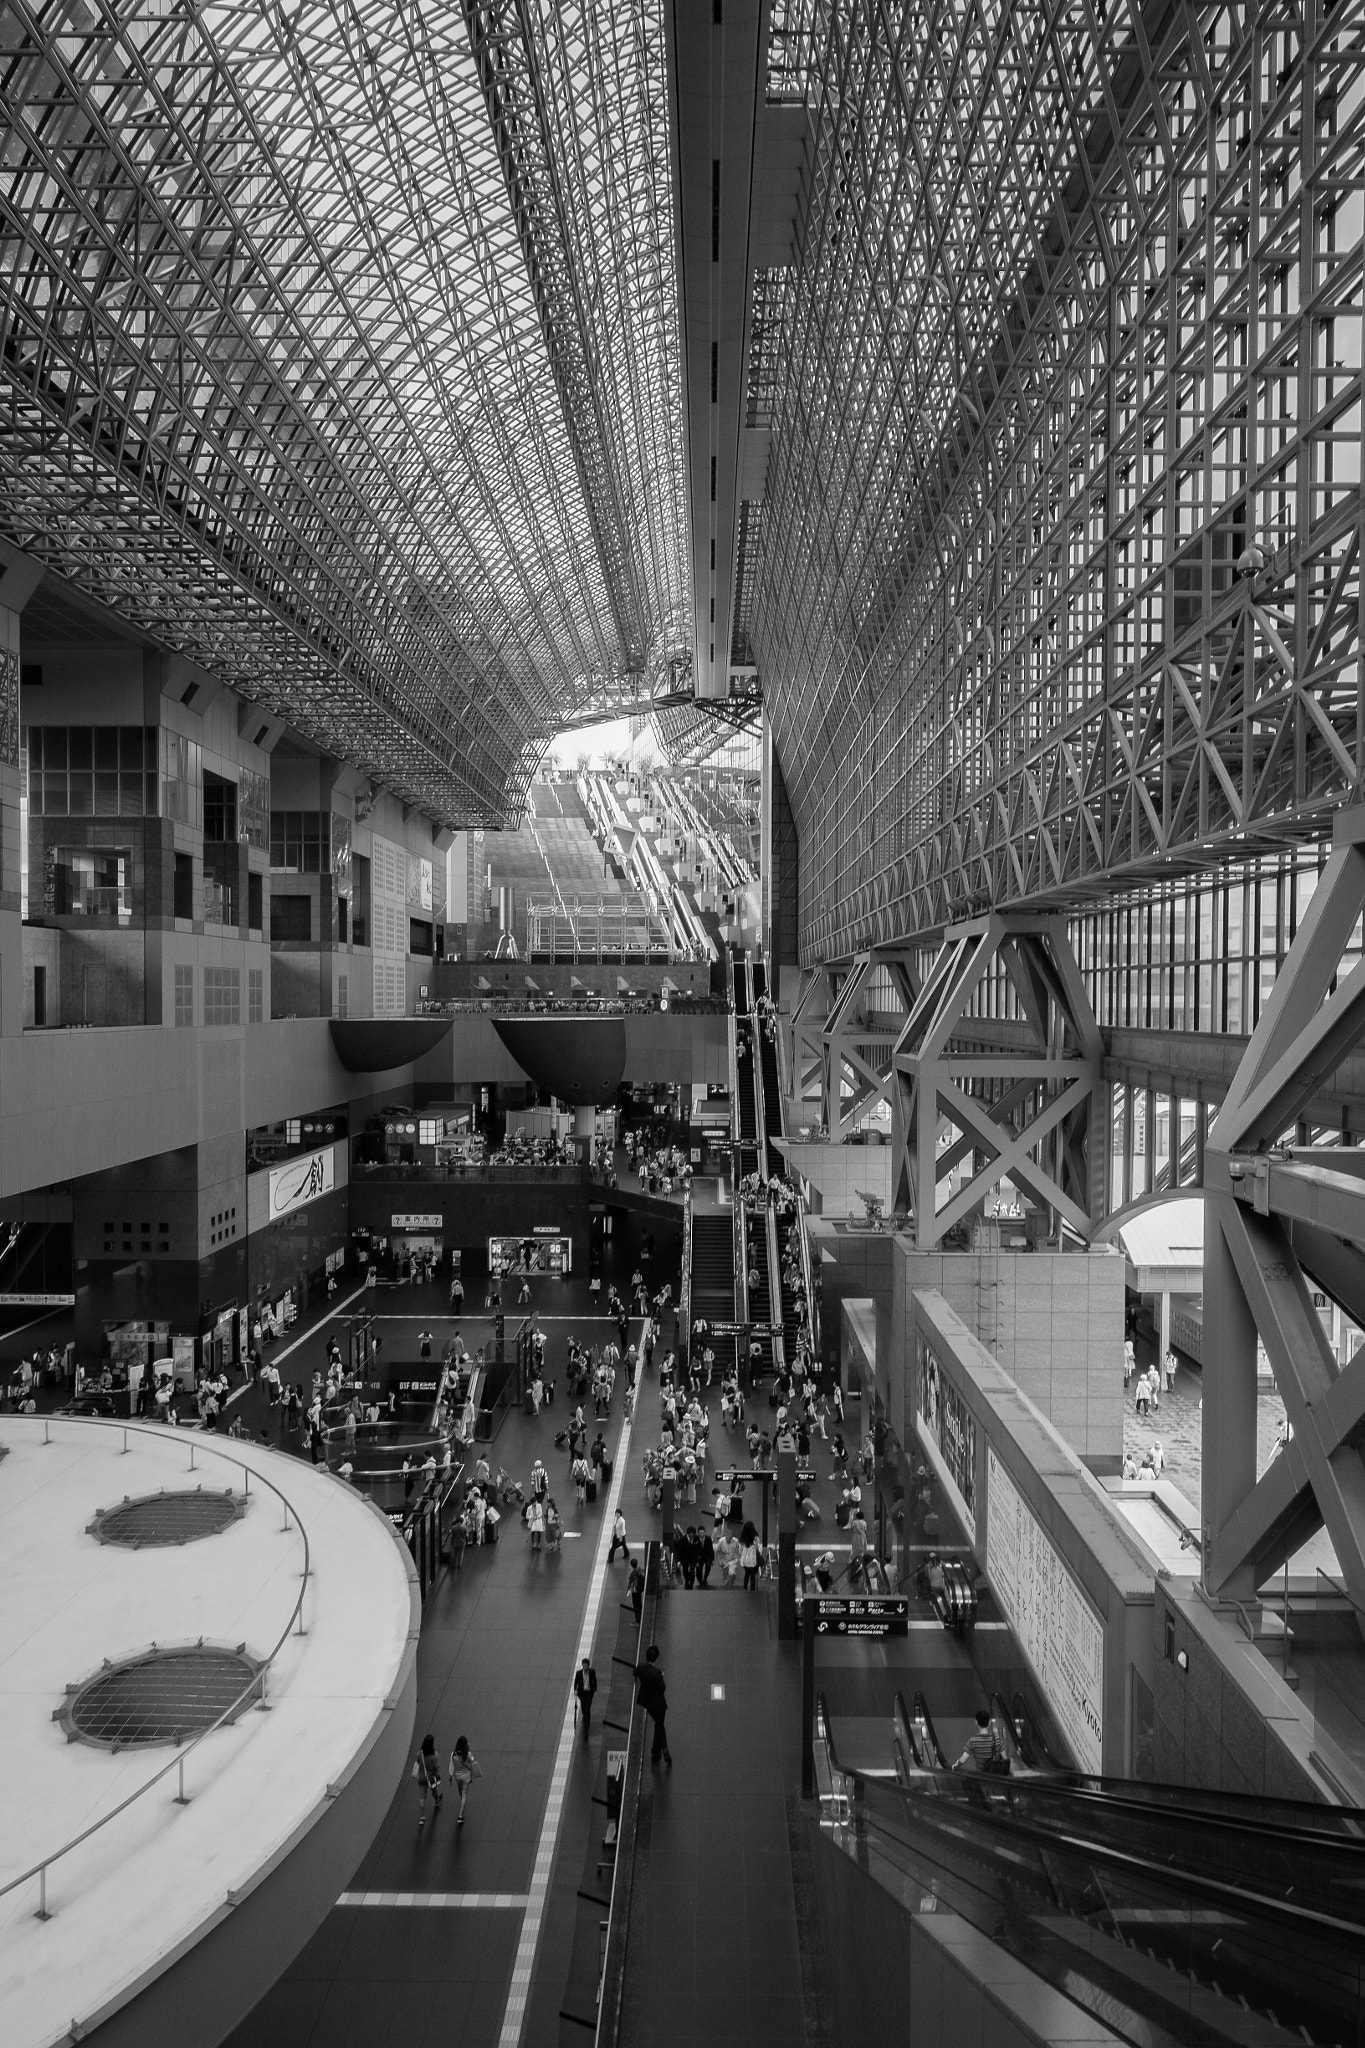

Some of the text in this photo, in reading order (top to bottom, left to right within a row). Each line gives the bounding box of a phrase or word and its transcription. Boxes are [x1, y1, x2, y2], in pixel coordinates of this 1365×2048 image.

[404, 1215, 430, 1224] 案内所
[399, 1381, 410, 1390] B1F
[1081, 1693, 1102, 1743] Kyoto
